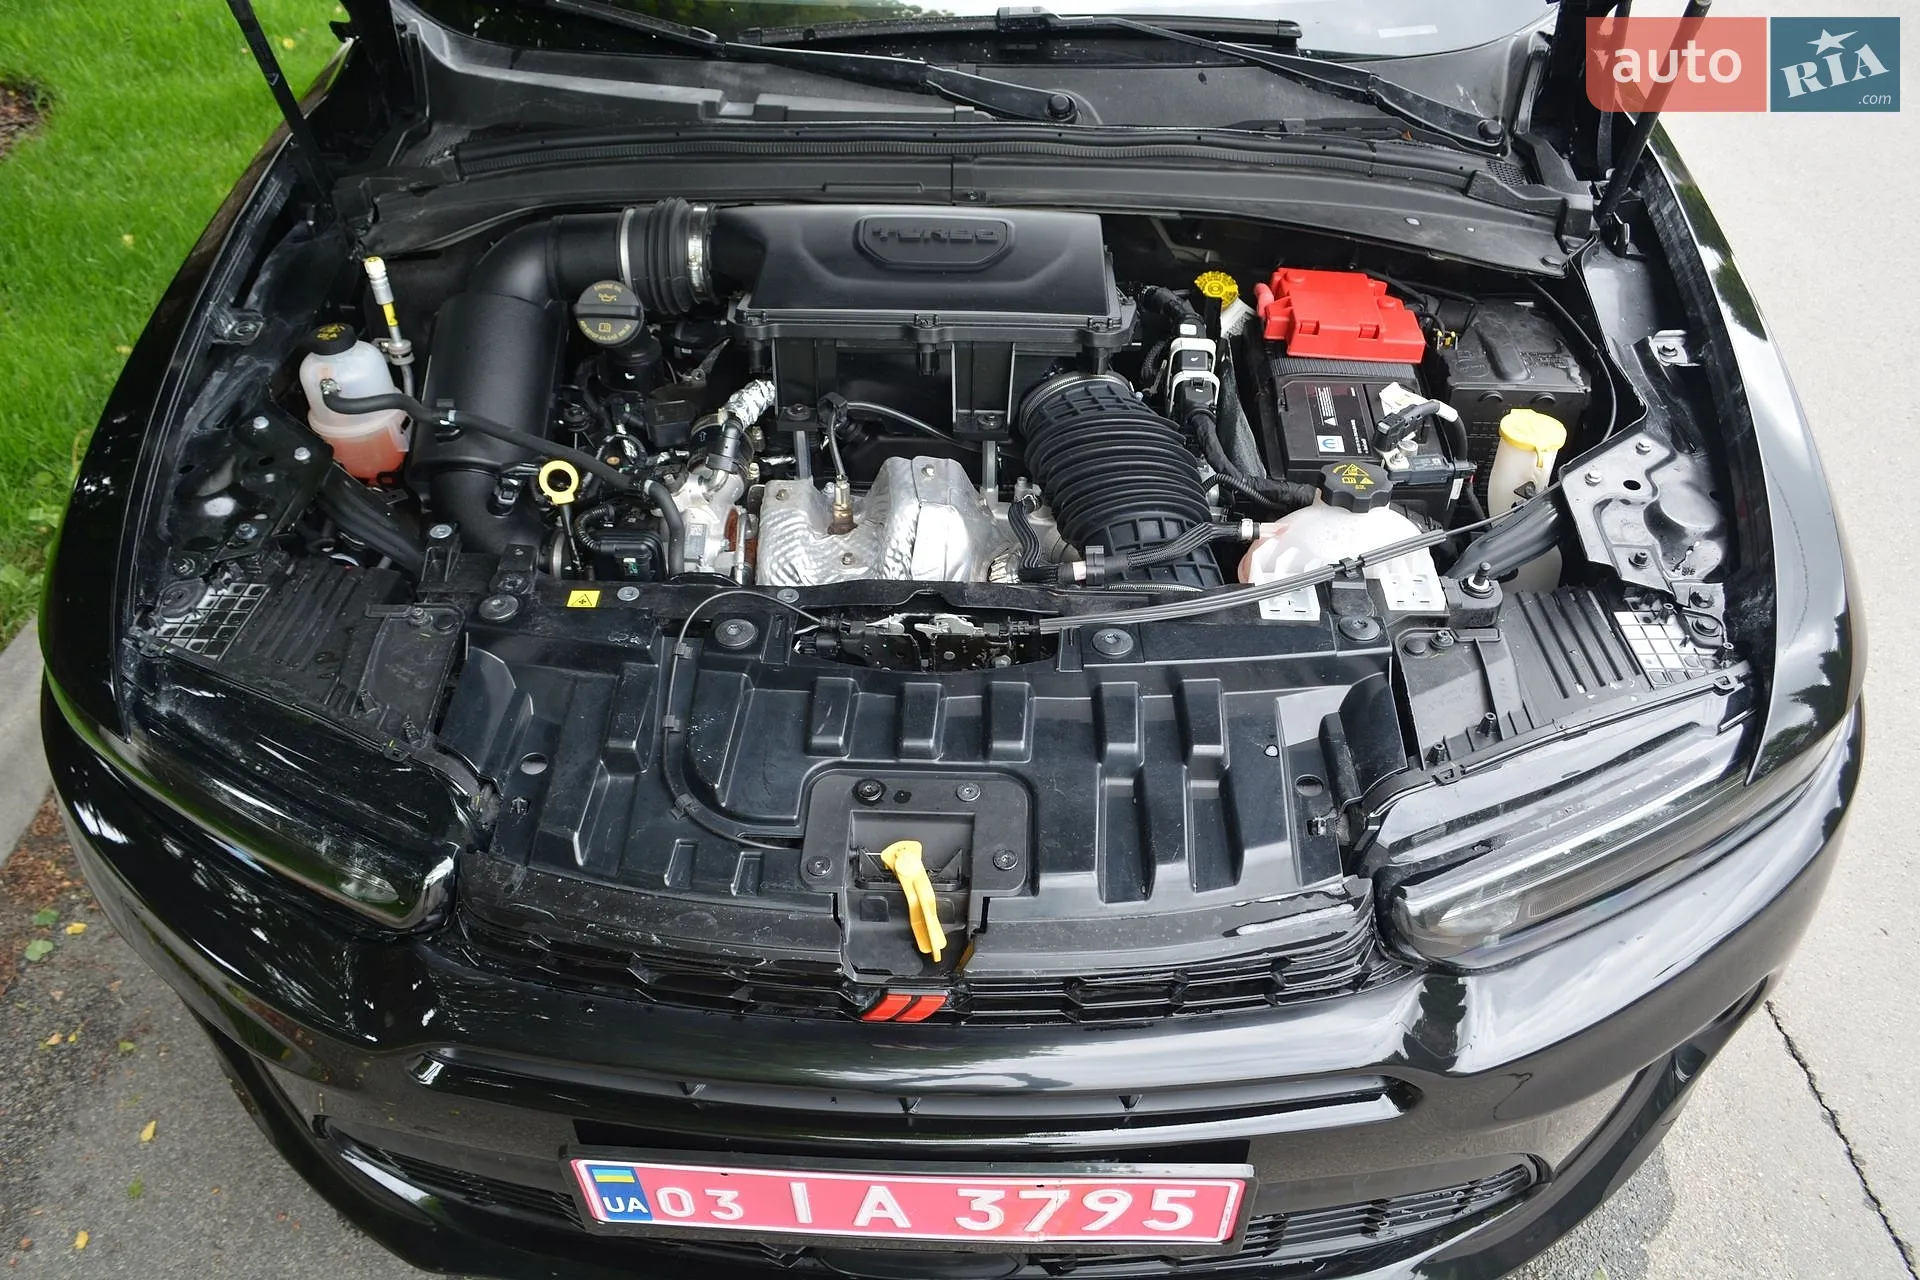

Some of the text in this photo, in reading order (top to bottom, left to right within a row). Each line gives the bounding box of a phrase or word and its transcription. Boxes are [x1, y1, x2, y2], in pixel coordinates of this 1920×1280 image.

[871, 226, 1000, 242] TURBO
[602, 1196, 648, 1213] UA
[655, 1187, 744, 1221] 03
[955, 1188, 1197, 1232] 3795
